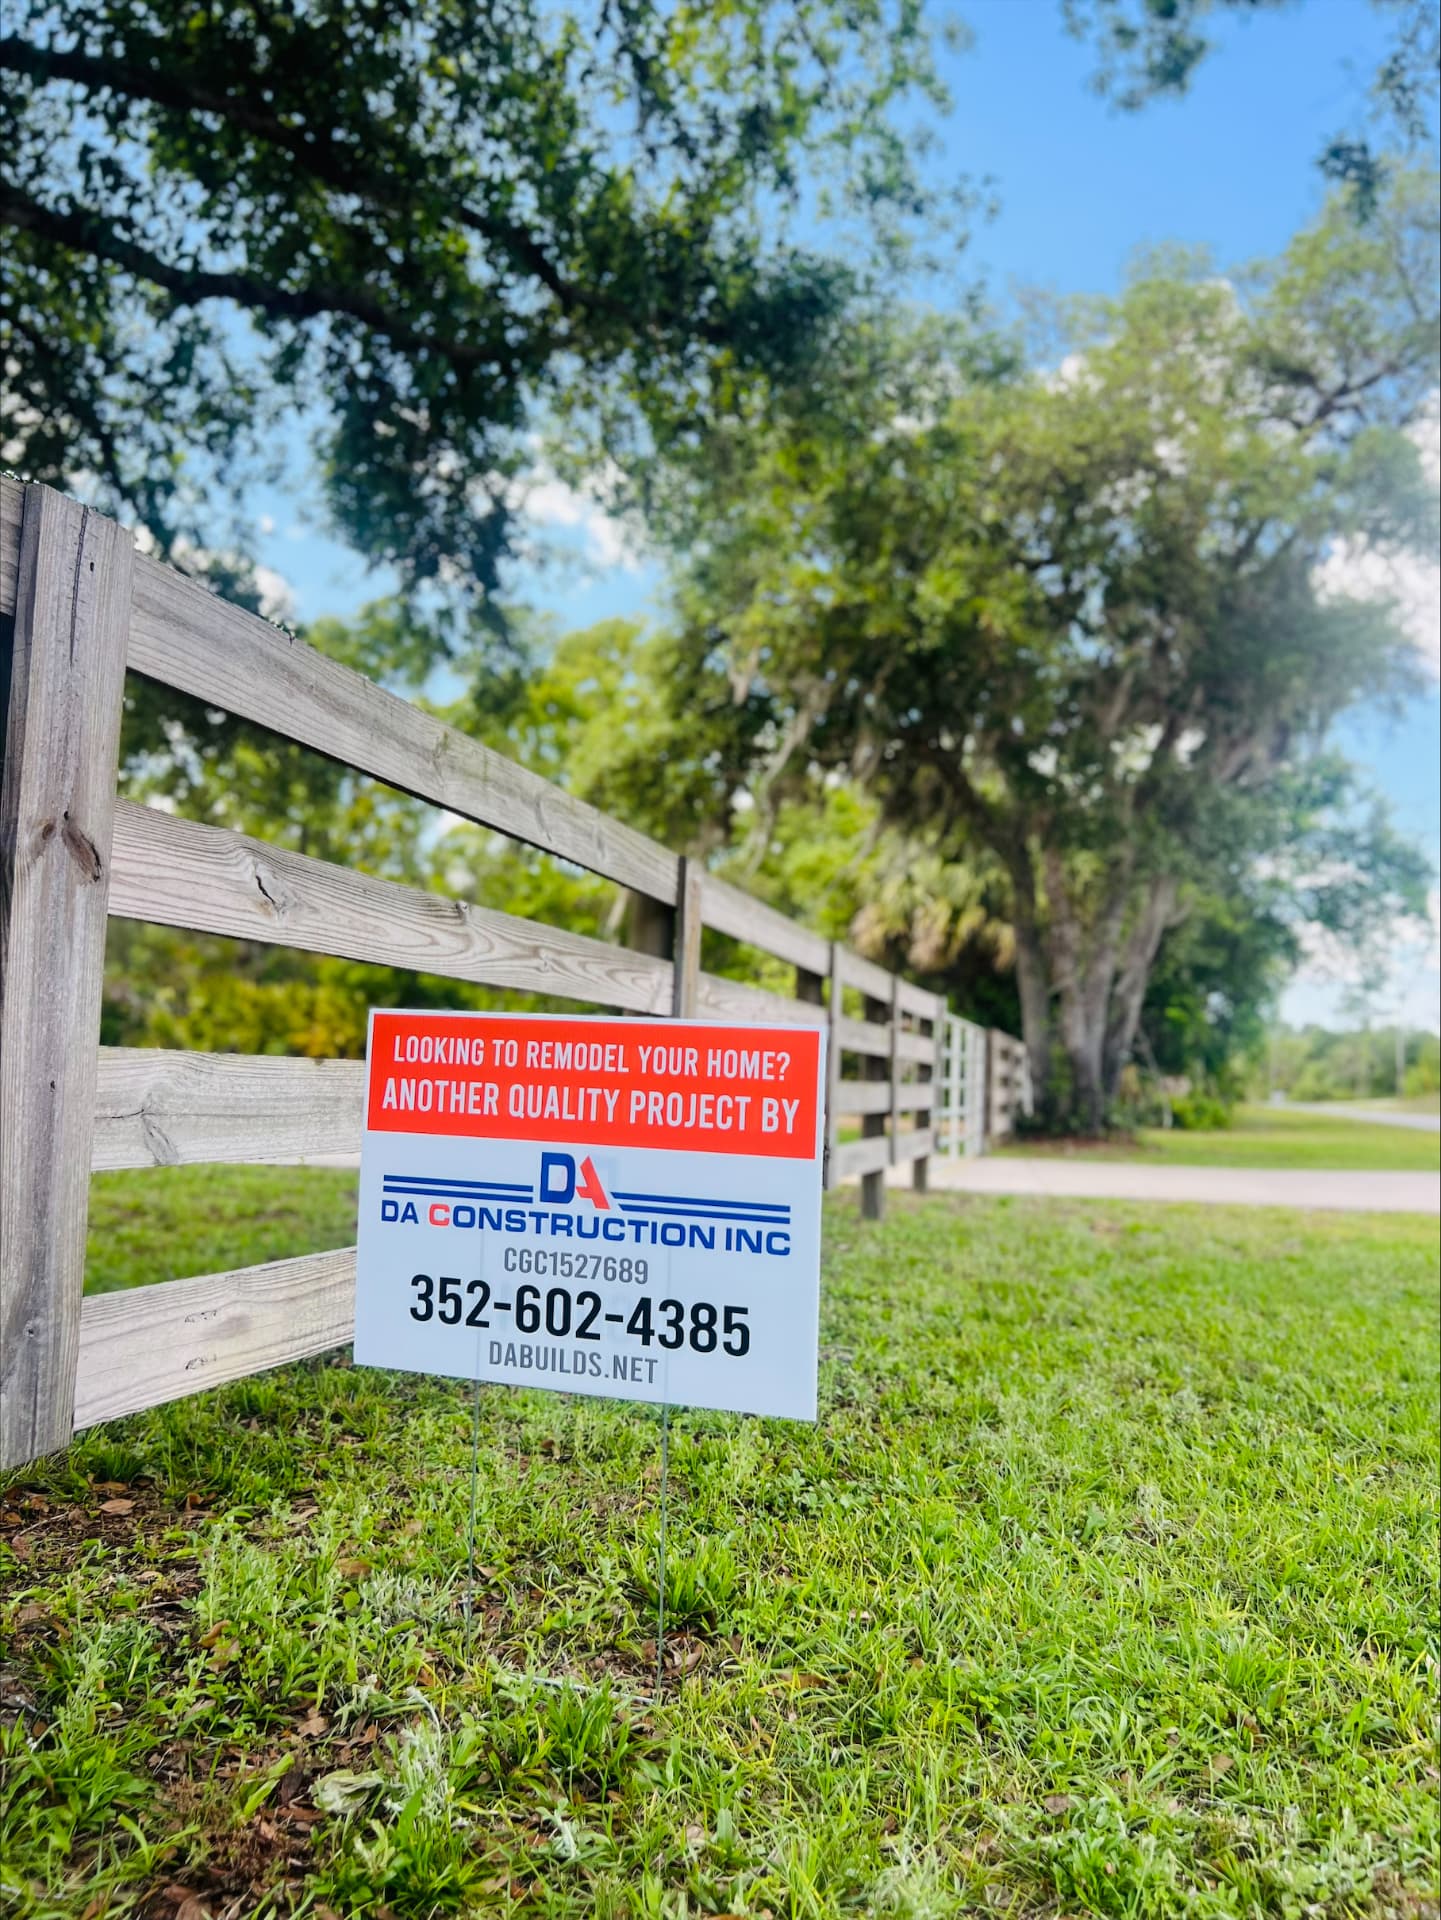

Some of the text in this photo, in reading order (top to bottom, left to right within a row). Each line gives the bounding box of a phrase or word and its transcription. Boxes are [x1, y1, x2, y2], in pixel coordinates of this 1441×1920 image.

[393, 1035, 791, 1081] LOOKING TO REMODEL YOUR HOME?
[382, 1077, 799, 1135] ANOTHER QUALITY PROJECT BY
[539, 1151, 611, 1210] DA
[381, 1200, 791, 1256] DA CONSTRUCTION INC
[503, 1247, 649, 1285] CGC1527689
[410, 1274, 751, 1357] 352-602-4385
[489, 1341, 658, 1384] DABUILDS.NET
